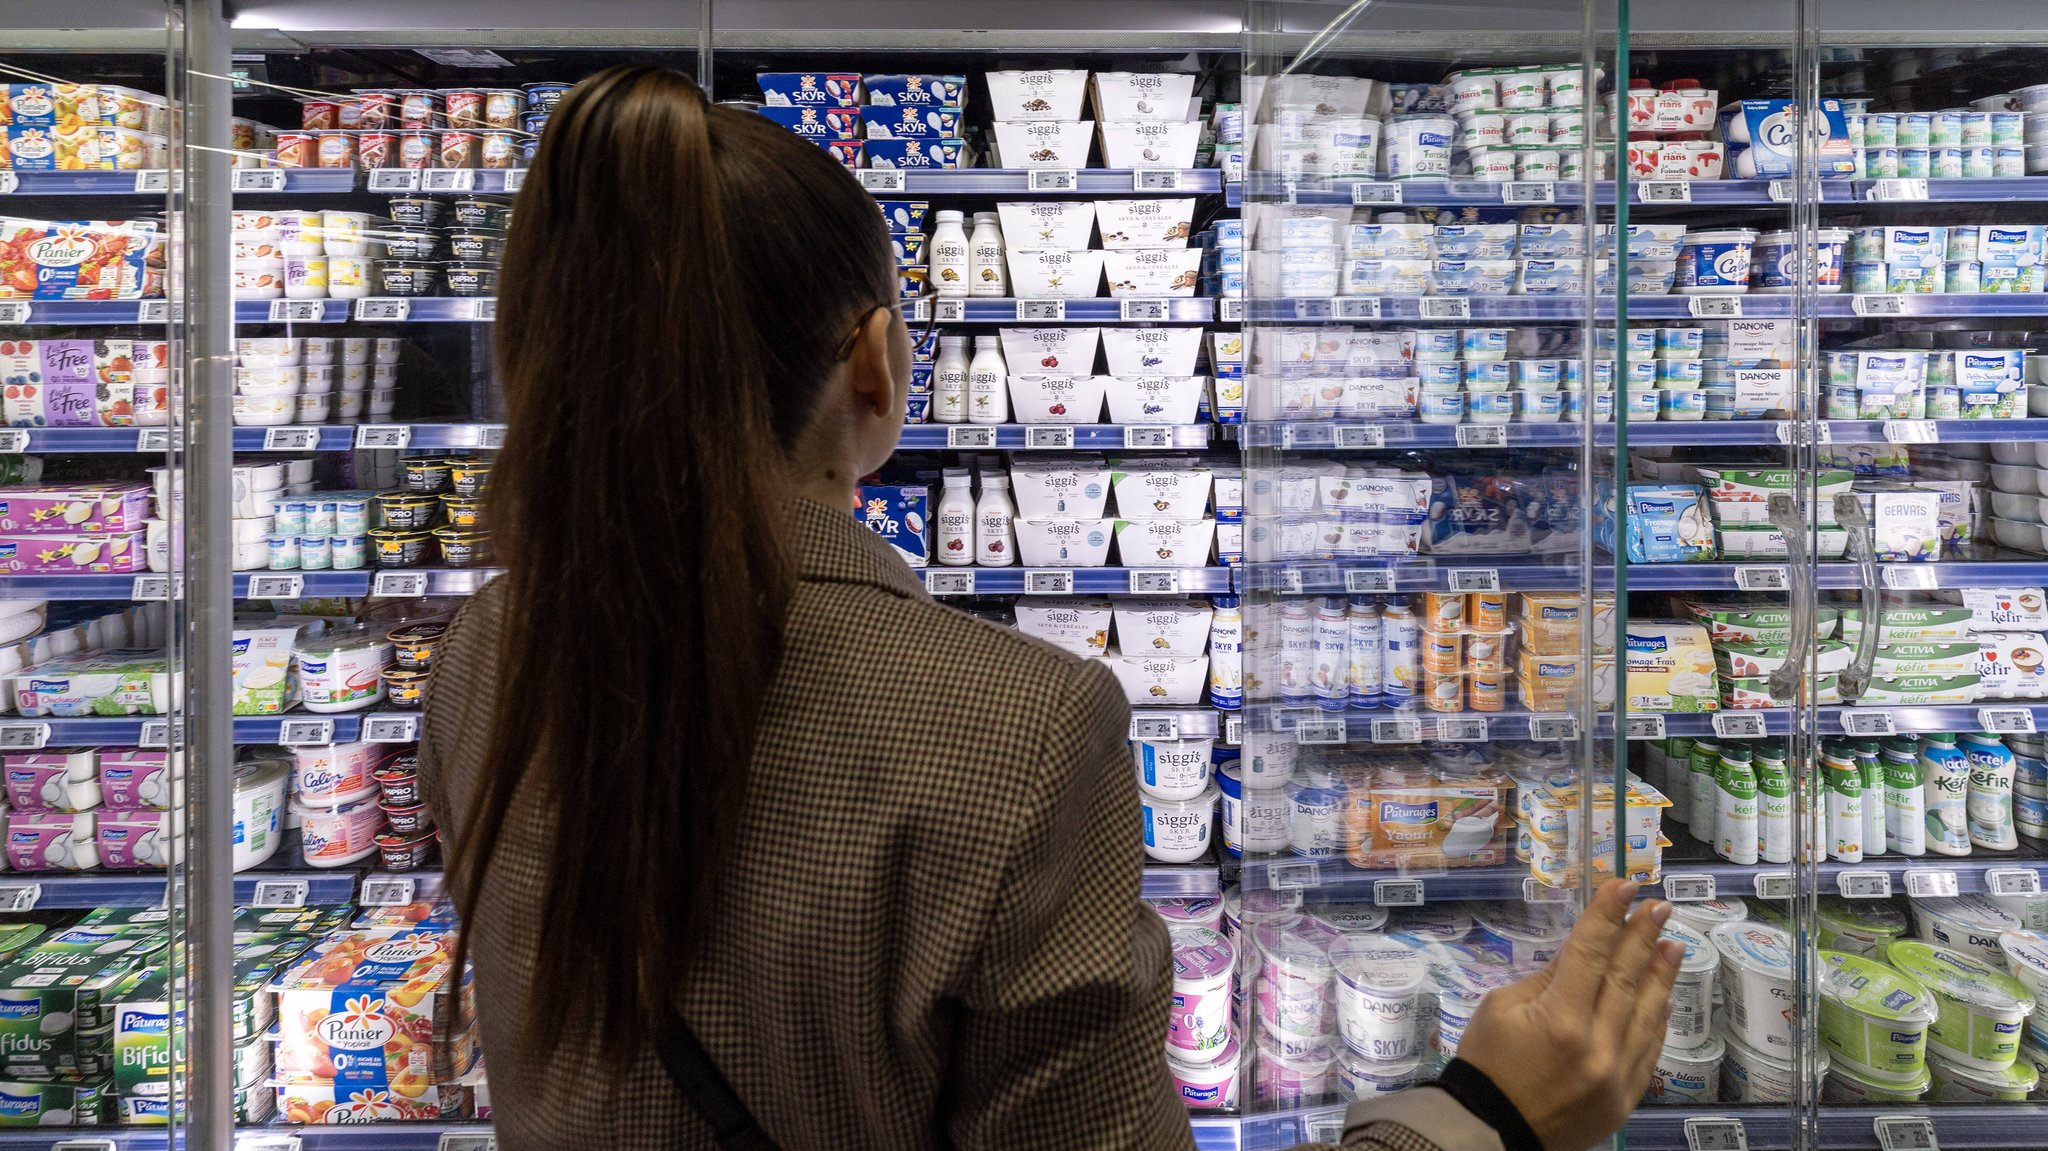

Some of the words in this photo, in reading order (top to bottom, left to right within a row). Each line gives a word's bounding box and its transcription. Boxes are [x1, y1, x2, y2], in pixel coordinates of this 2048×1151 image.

[792, 88, 826, 101] SKYR
[898, 89, 930, 102] SKYR
[1660, 100, 1681, 108] rians
[793, 121, 826, 134] SKYR
[894, 120, 926, 132] SKYR
[898, 154, 930, 166] SKYR
[1663, 153, 1686, 161] rians
[1896, 232, 1928, 242] Pâturages
[1990, 231, 2027, 242] Pâturages
[37, 244, 84, 259] Panier
[1733, 322, 1774, 330] DANONE
[58, 349, 88, 370] Free
[1869, 358, 1906, 369] Pâturages
[1967, 357, 2004, 367] Pâturages
[1741, 373, 1781, 381] DANONE
[61, 393, 90, 414] Free
[1356, 402, 1375, 410] SKYR
[1642, 503, 1673, 514] Pâturages
[1885, 506, 1927, 516] GERVAIS
[1357, 546, 1376, 554] SKYR
[1886, 613, 1927, 621] ACTIVIA
[1991, 611, 2022, 624] kéfir
[1757, 631, 1784, 640] kéfir
[1889, 630, 1919, 639] kéfir
[1215, 641, 1232, 650] SKYR
[1354, 639, 1373, 647] SKYR
[1896, 663, 1926, 672] kéfir
[1900, 695, 1928, 704] kéfir
[1159, 751, 1200, 766] siggi's
[1385, 805, 1436, 819] Pâturages
[1157, 813, 1200, 828] siggi's
[1386, 830, 1433, 840] Yaourt
[1310, 847, 1329, 855] SKYR
[372, 945, 426, 957] Panier
[22, 952, 92, 967] Bifidus
[0, 1002, 38, 1015] turages
[1363, 1000, 1414, 1013] DANONE
[329, 1020, 383, 1040] Panier
[1, 1034, 52, 1054] fidus
[1374, 1039, 1407, 1055] SKYR
[1184, 1087, 1217, 1098] Pâturages
